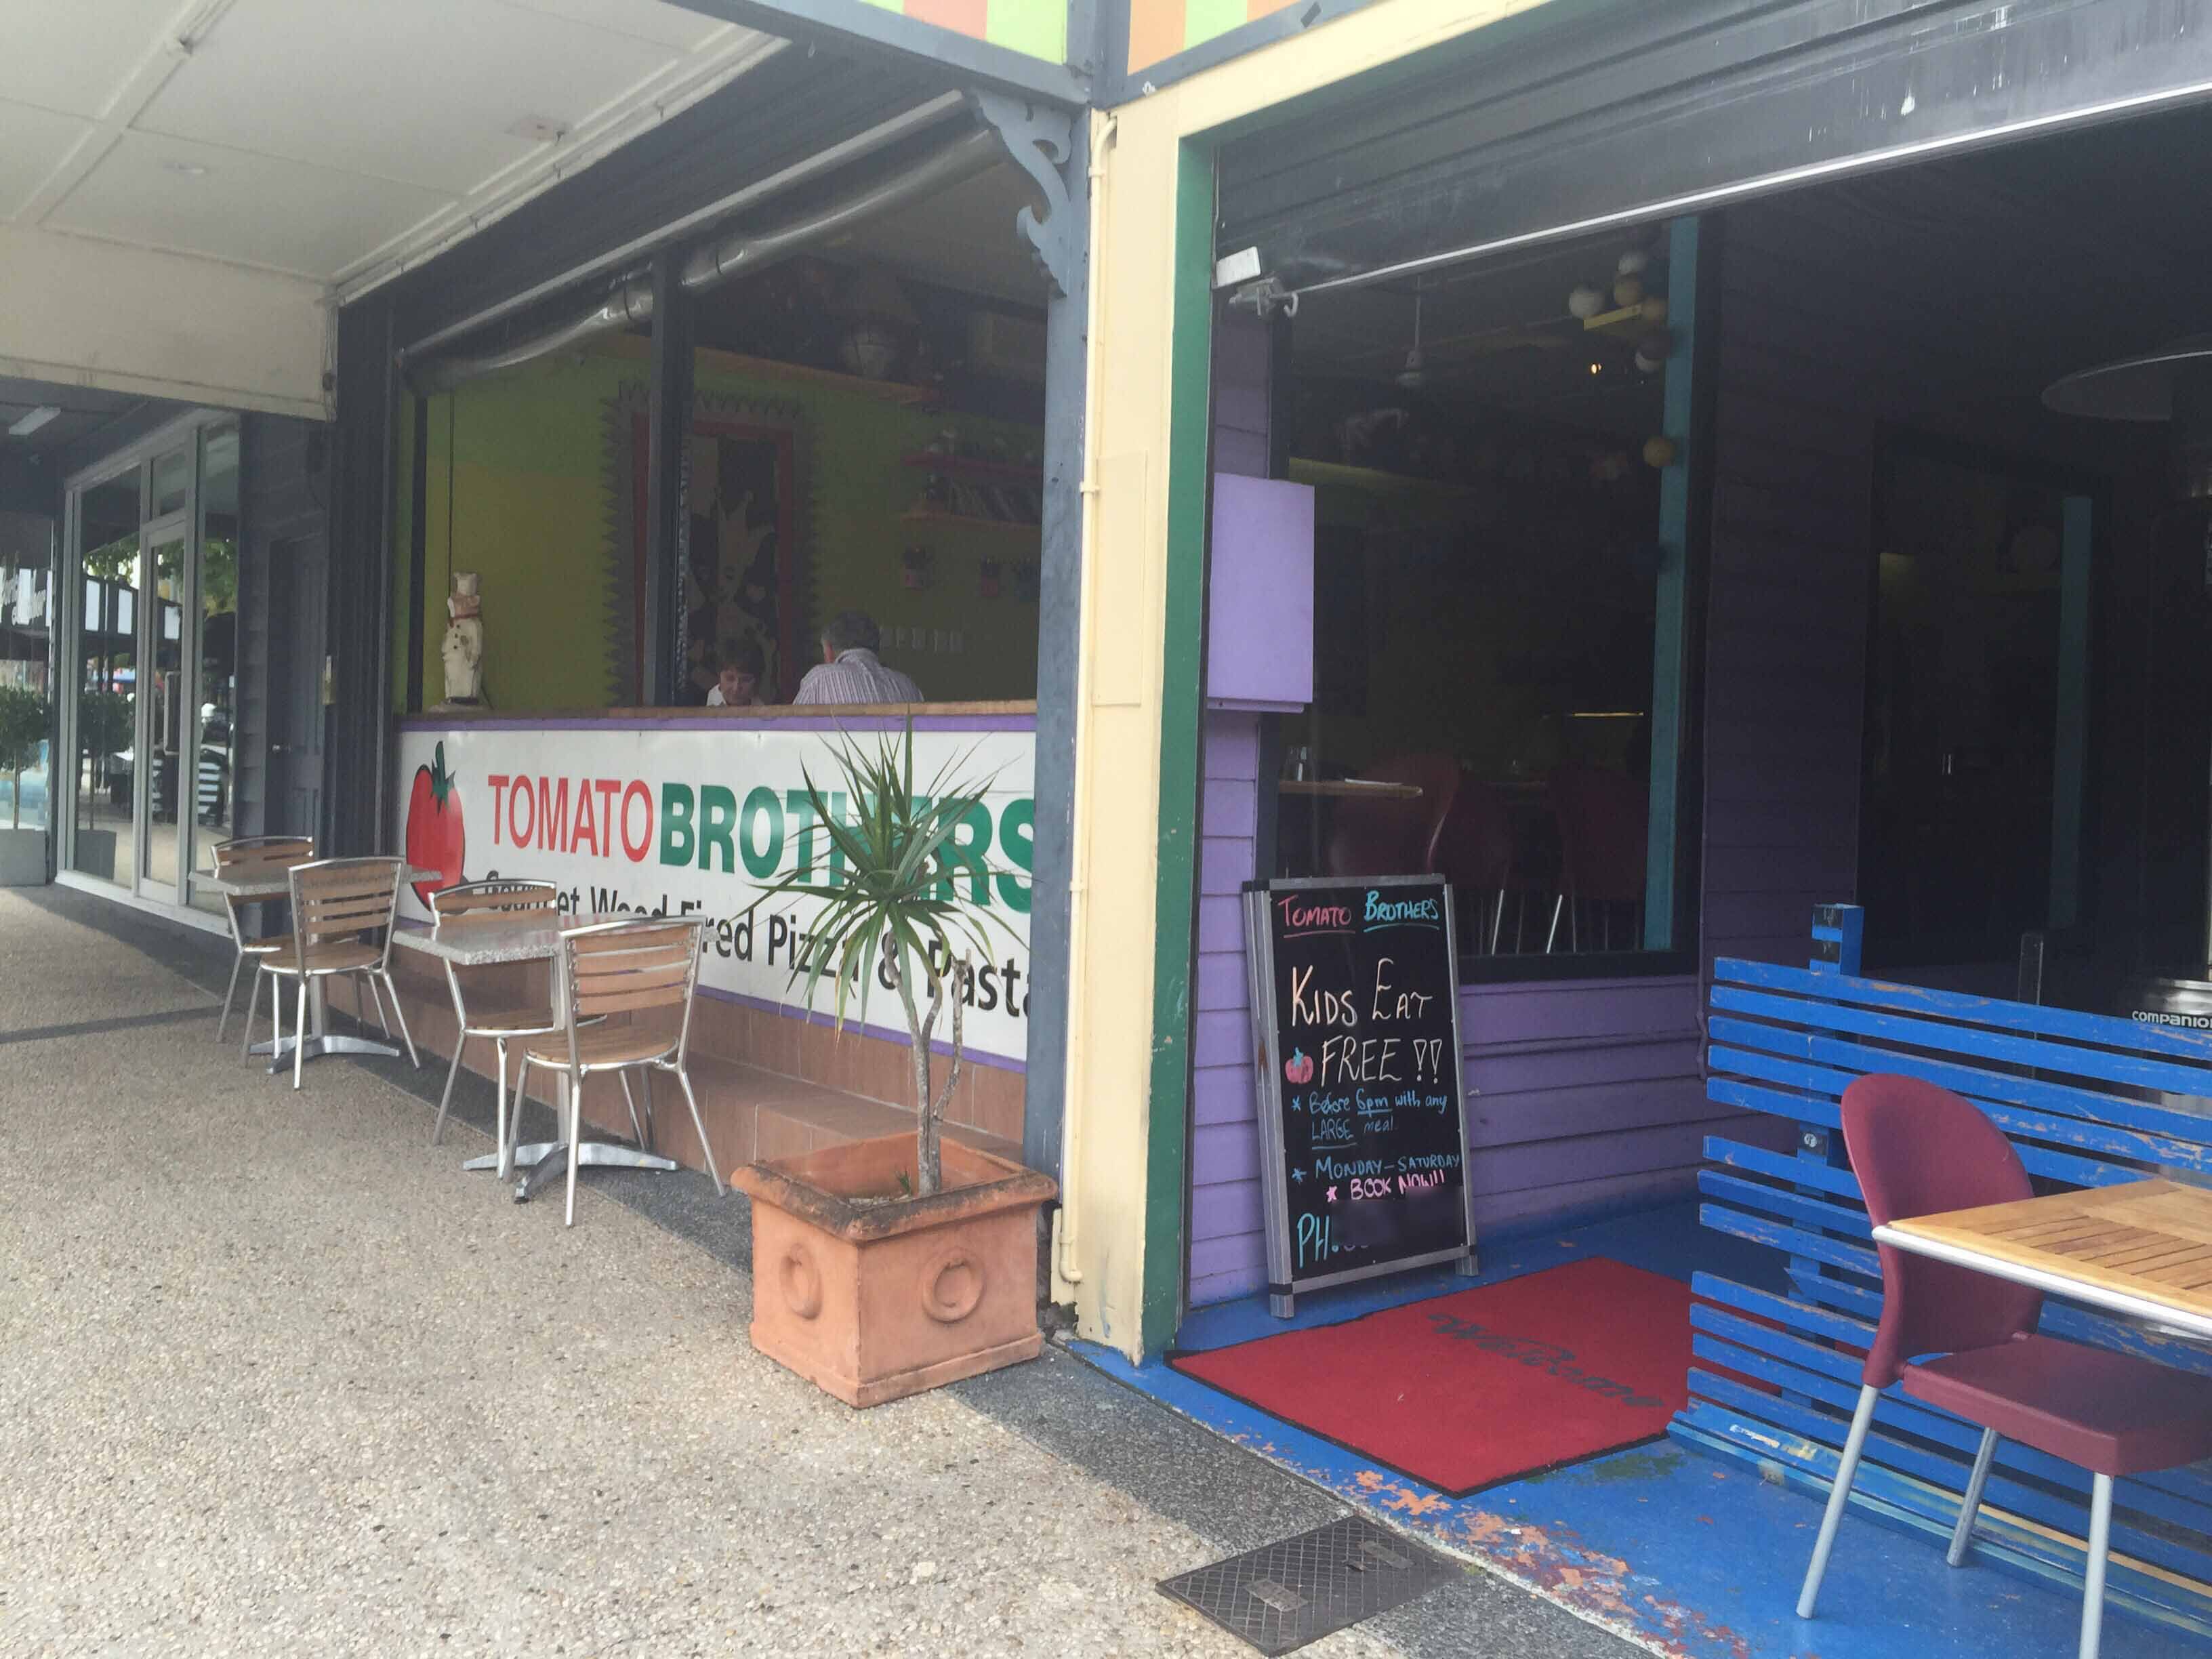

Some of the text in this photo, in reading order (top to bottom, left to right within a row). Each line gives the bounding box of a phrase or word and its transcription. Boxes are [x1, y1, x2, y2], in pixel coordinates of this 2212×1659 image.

[488, 775, 654, 863] TOMATO
[680, 900, 754, 962] red
[768, 914, 860, 982] Piz
[927, 939, 1029, 1017] Past
[2132, 1010, 2212, 1029] companio
[1321, 1035, 1402, 1087] FREE
[1309, 1088, 1448, 1118] Before 6pm with any
[1311, 1118, 1354, 1141] LARGE
[1349, 1176, 1392, 1200] BOOK
